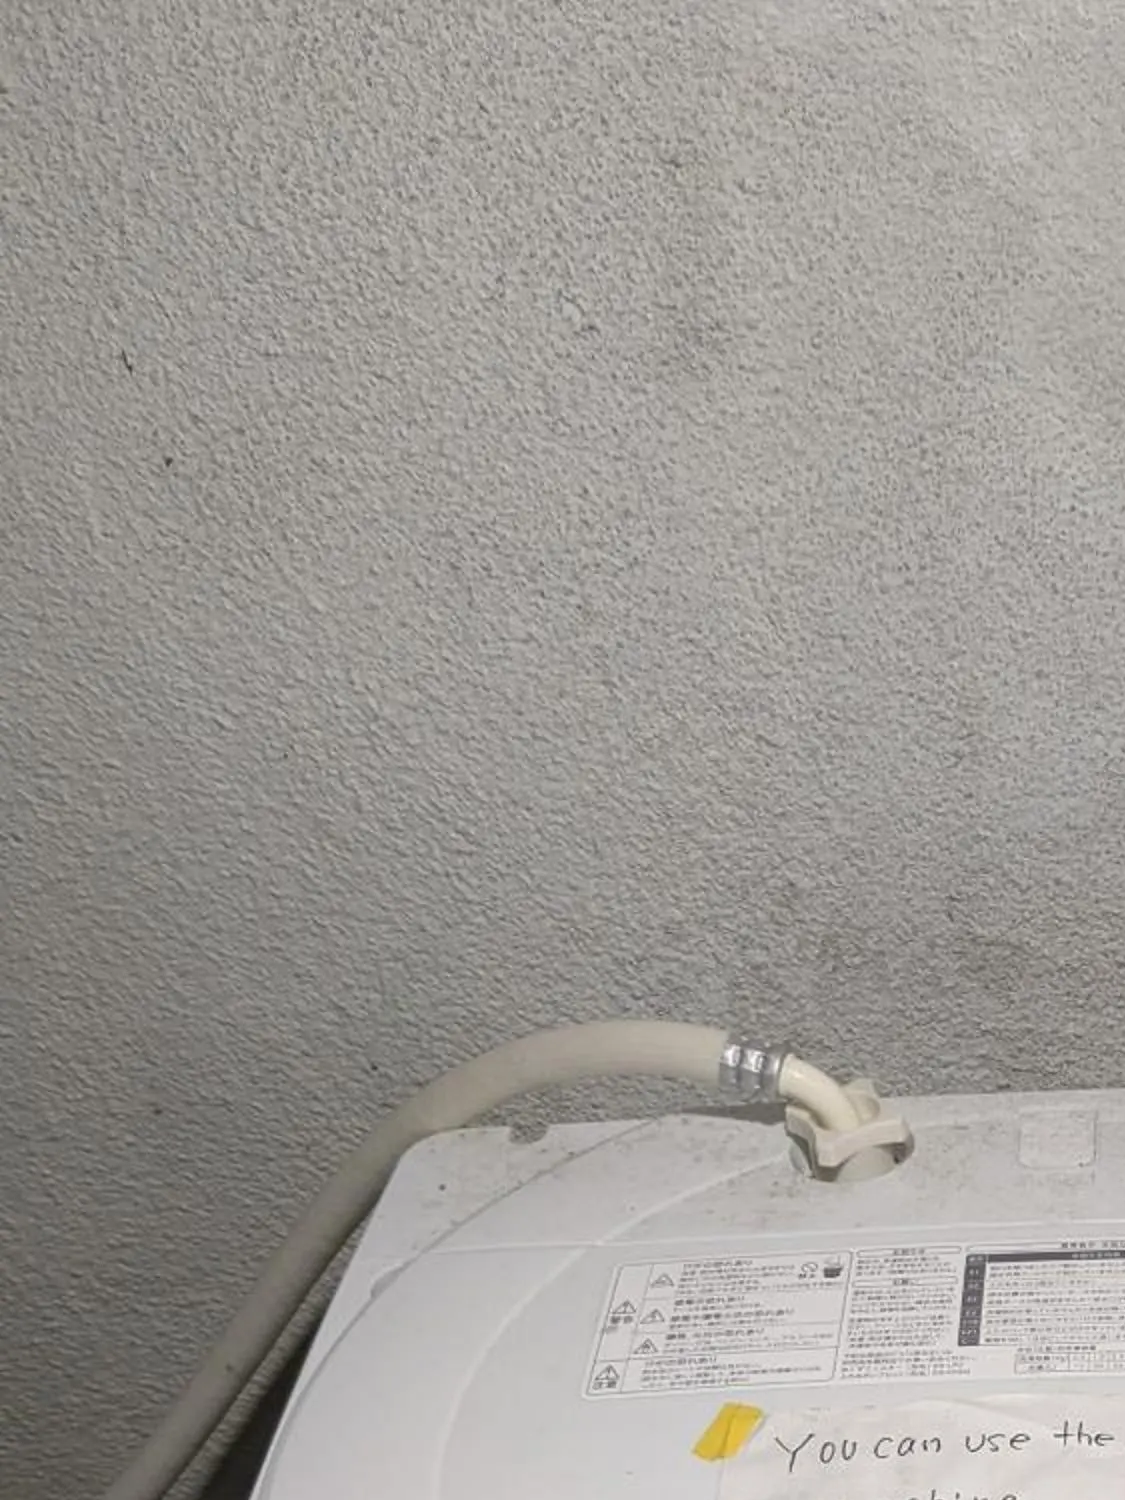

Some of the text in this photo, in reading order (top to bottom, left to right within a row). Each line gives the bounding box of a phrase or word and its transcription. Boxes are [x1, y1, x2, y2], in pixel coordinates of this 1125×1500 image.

[774, 1432, 858, 1474] You
[873, 1435, 943, 1458] can
[964, 1430, 1032, 1453] use
[1053, 1421, 1115, 1450] the
